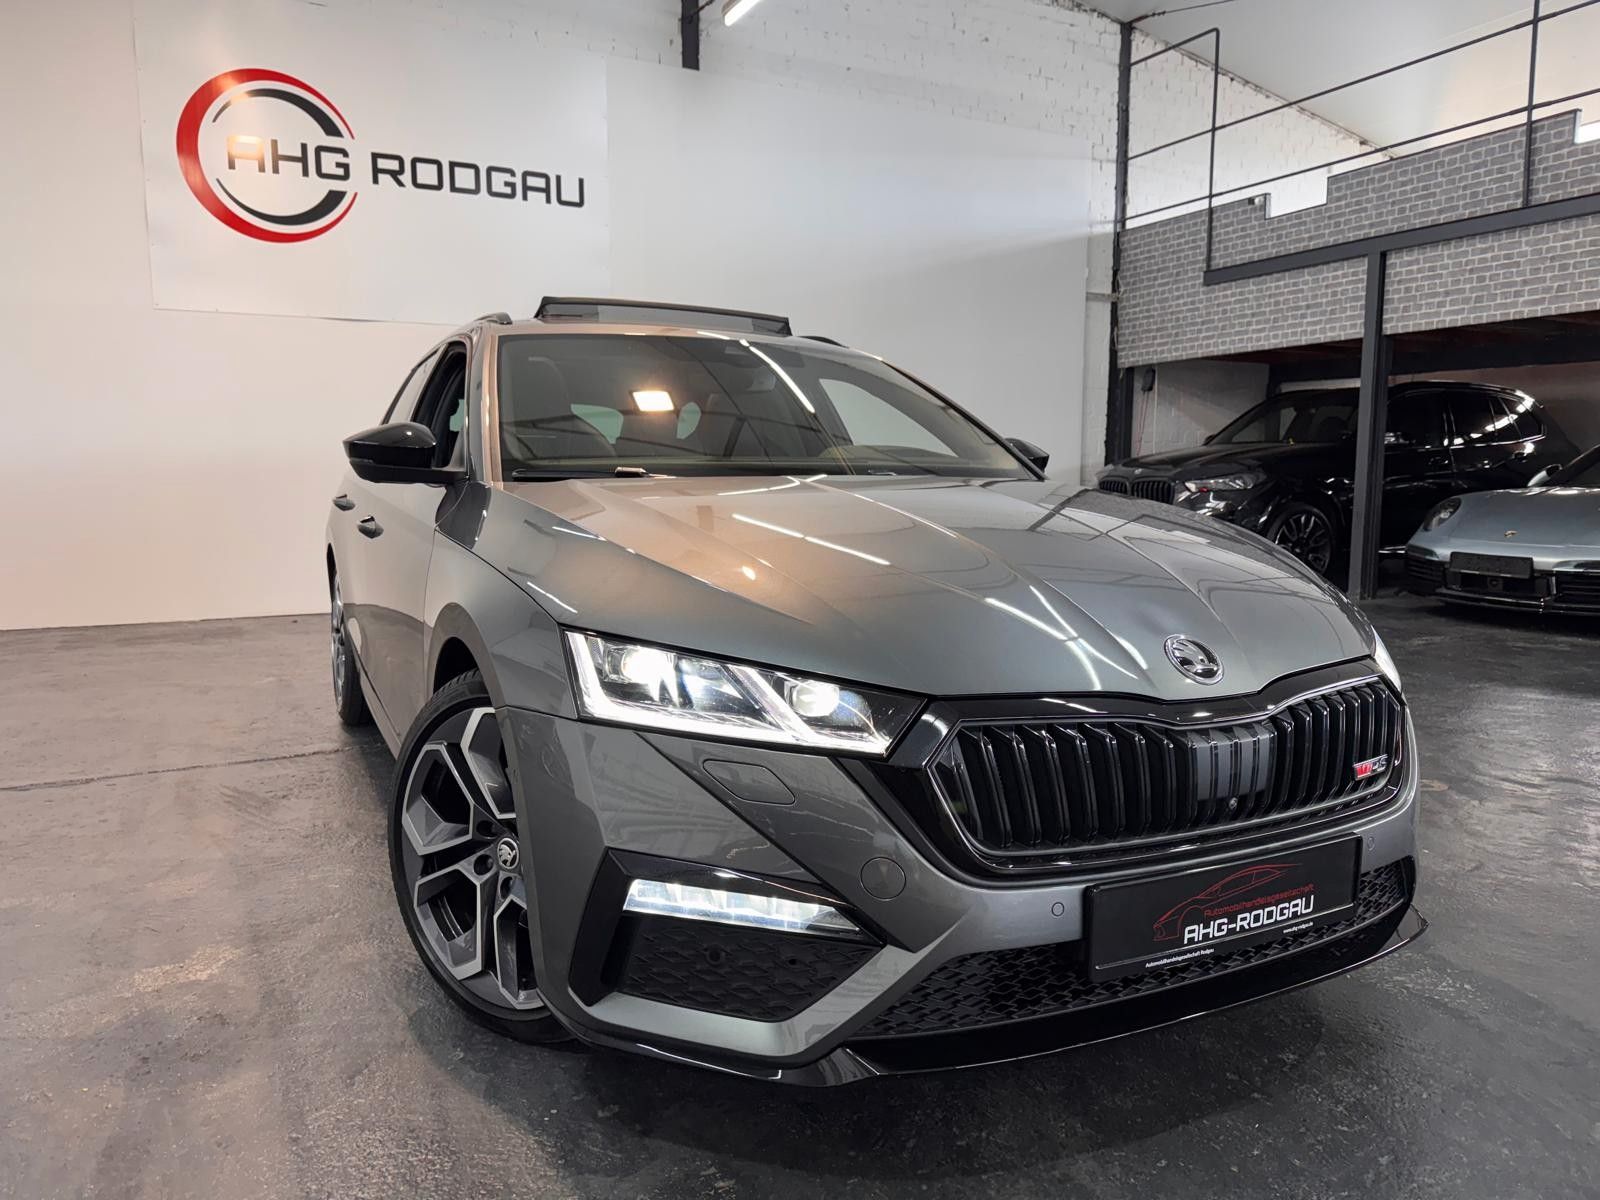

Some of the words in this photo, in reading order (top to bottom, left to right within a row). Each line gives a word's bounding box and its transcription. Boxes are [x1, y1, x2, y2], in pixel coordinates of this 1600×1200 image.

[226, 134, 350, 182] AHG
[370, 151, 585, 208] RODGAU
[1183, 894, 1315, 945] AHG-RODGAU
